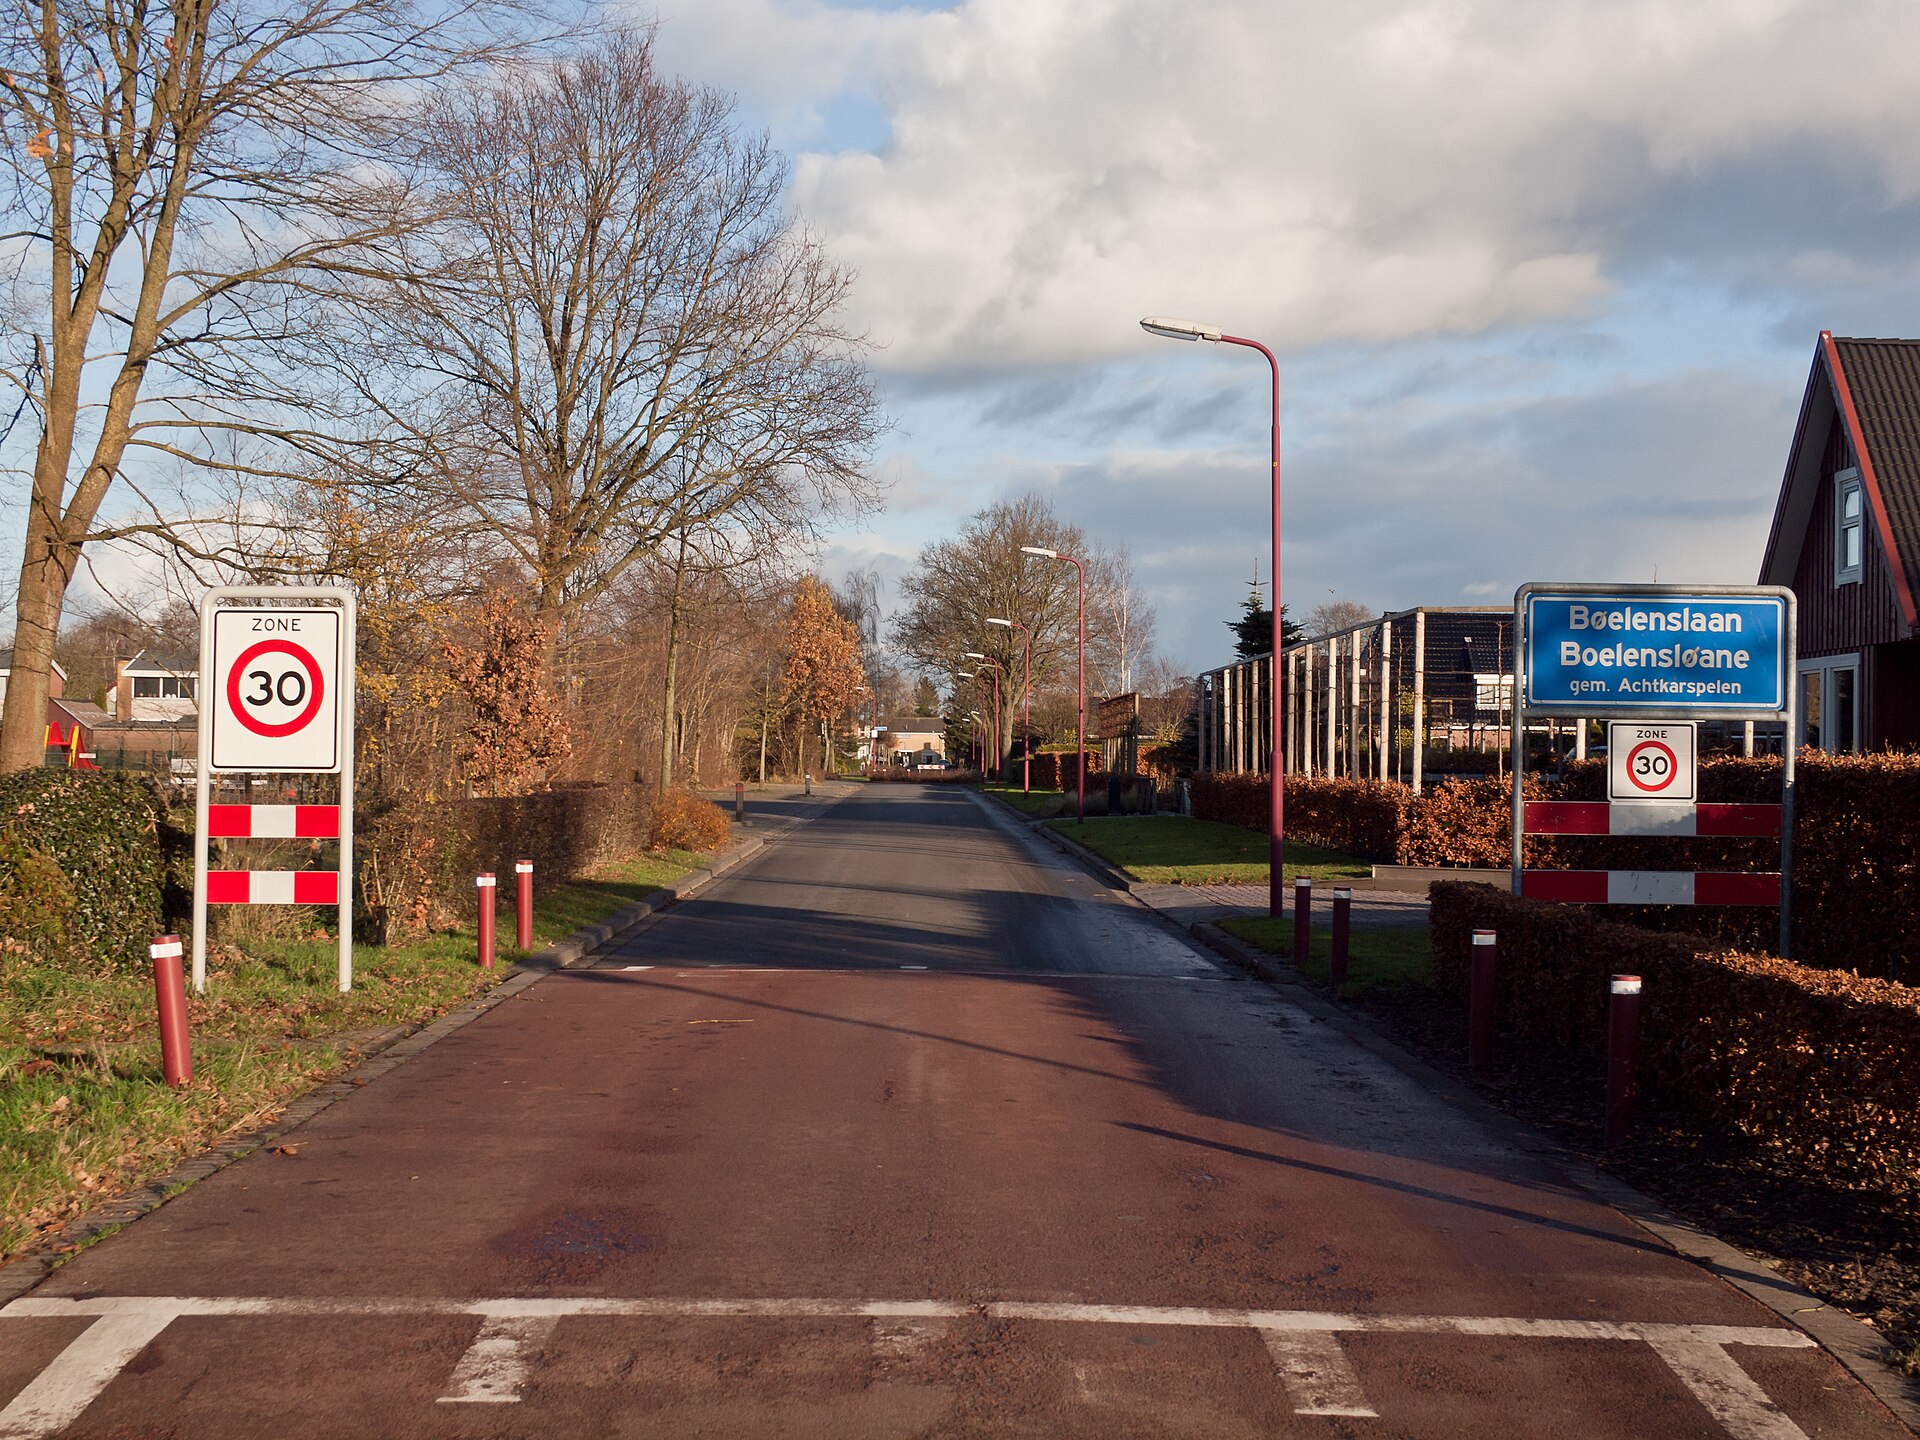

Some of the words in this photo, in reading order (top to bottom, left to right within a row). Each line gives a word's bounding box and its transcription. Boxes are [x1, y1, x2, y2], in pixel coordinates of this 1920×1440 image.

[252, 618, 301, 631] ZONE
[246, 671, 305, 706] 30
[1570, 679, 1610, 696] gem.
[1618, 678, 1742, 697] Achtkarspelen
[1636, 730, 1668, 739] ZONE
[1635, 756, 1668, 775] 30
